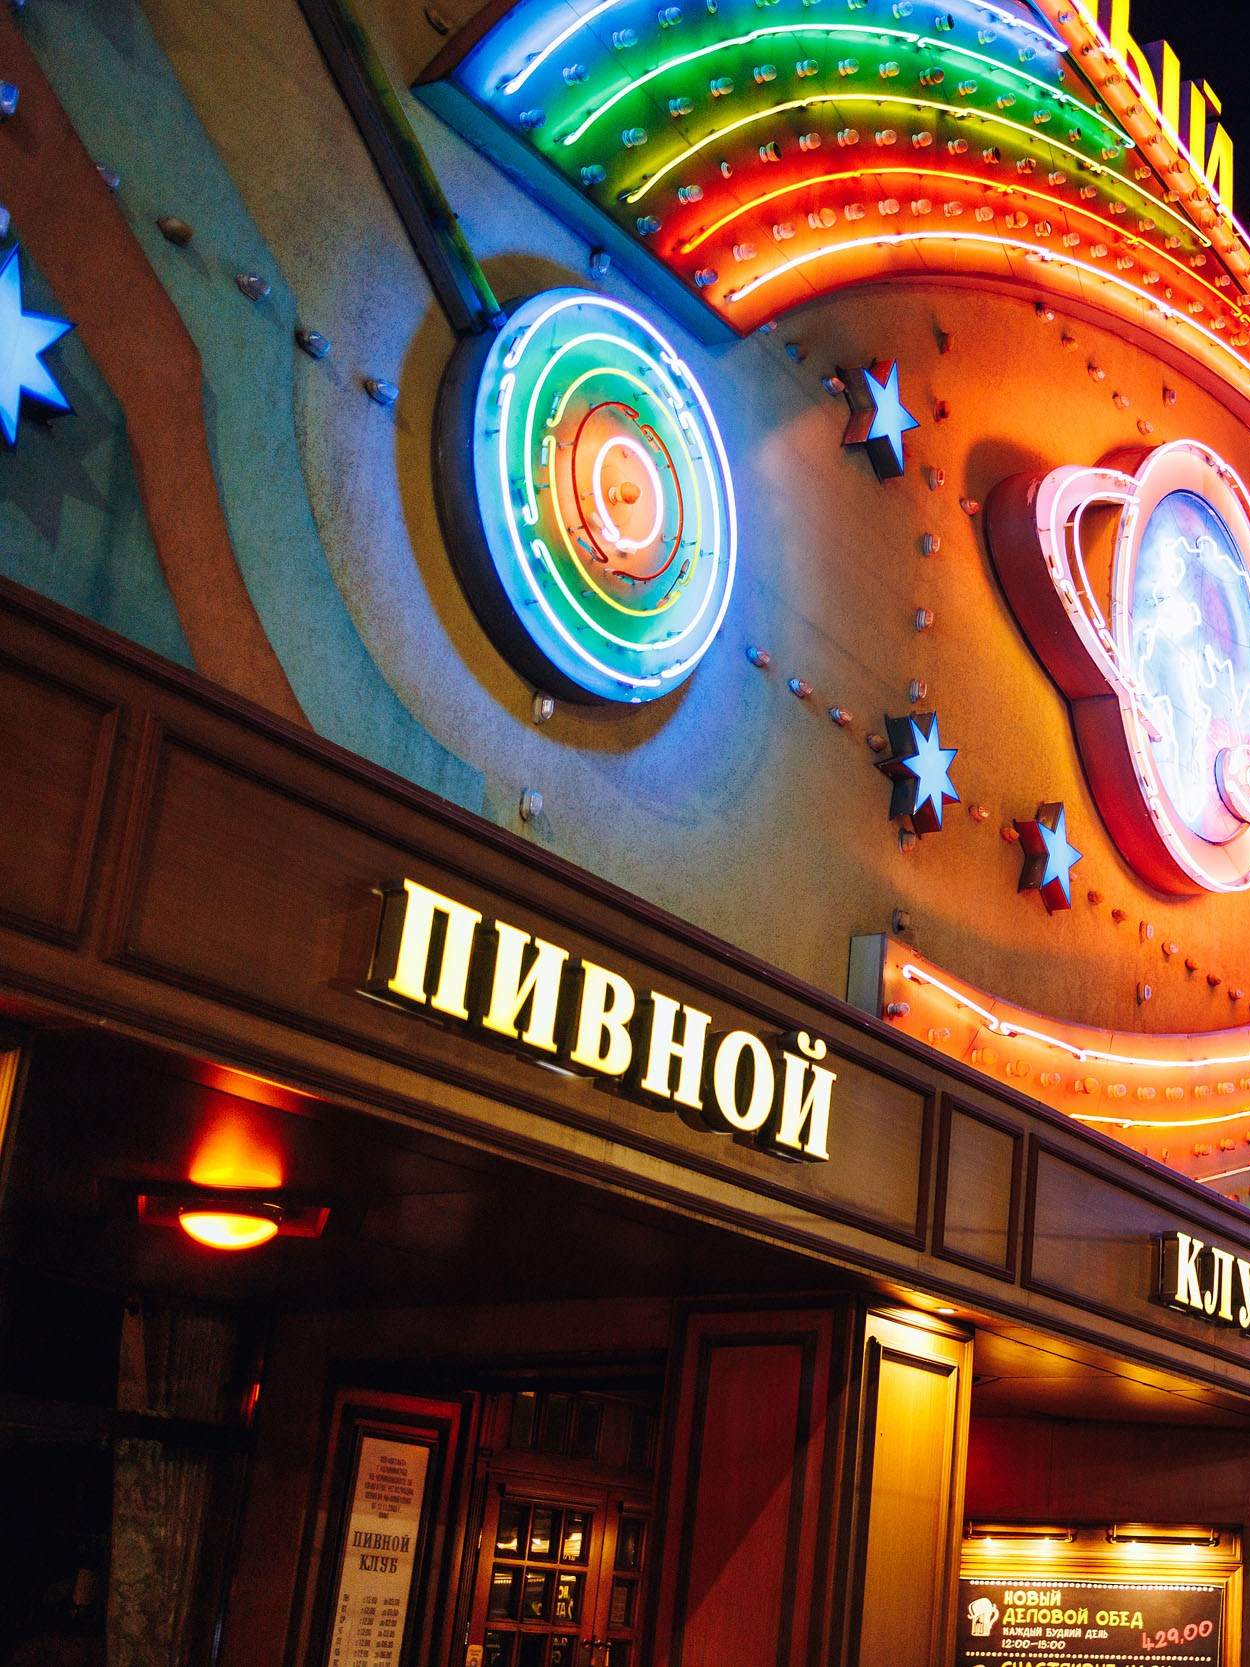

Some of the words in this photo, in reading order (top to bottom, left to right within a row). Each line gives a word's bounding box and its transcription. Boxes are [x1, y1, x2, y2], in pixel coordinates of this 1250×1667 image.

[387, 877, 838, 1161] ПИВНОЙ
[352, 1529, 411, 1553] ПИВНОЙ
[358, 1553, 399, 1574] КЛУБ
[1003, 1589, 1062, 1607] НОВЫЙ
[1002, 1607, 1089, 1626] ДЕЛОВОЙ
[1095, 1610, 1144, 1629] ОБЕД
[1003, 1626, 1043, 1637] КАЖДЫЙ
[1045, 1626, 1082, 1639] БУДНИЙ
[1084, 1628, 1109, 1640] ДЕНЬ
